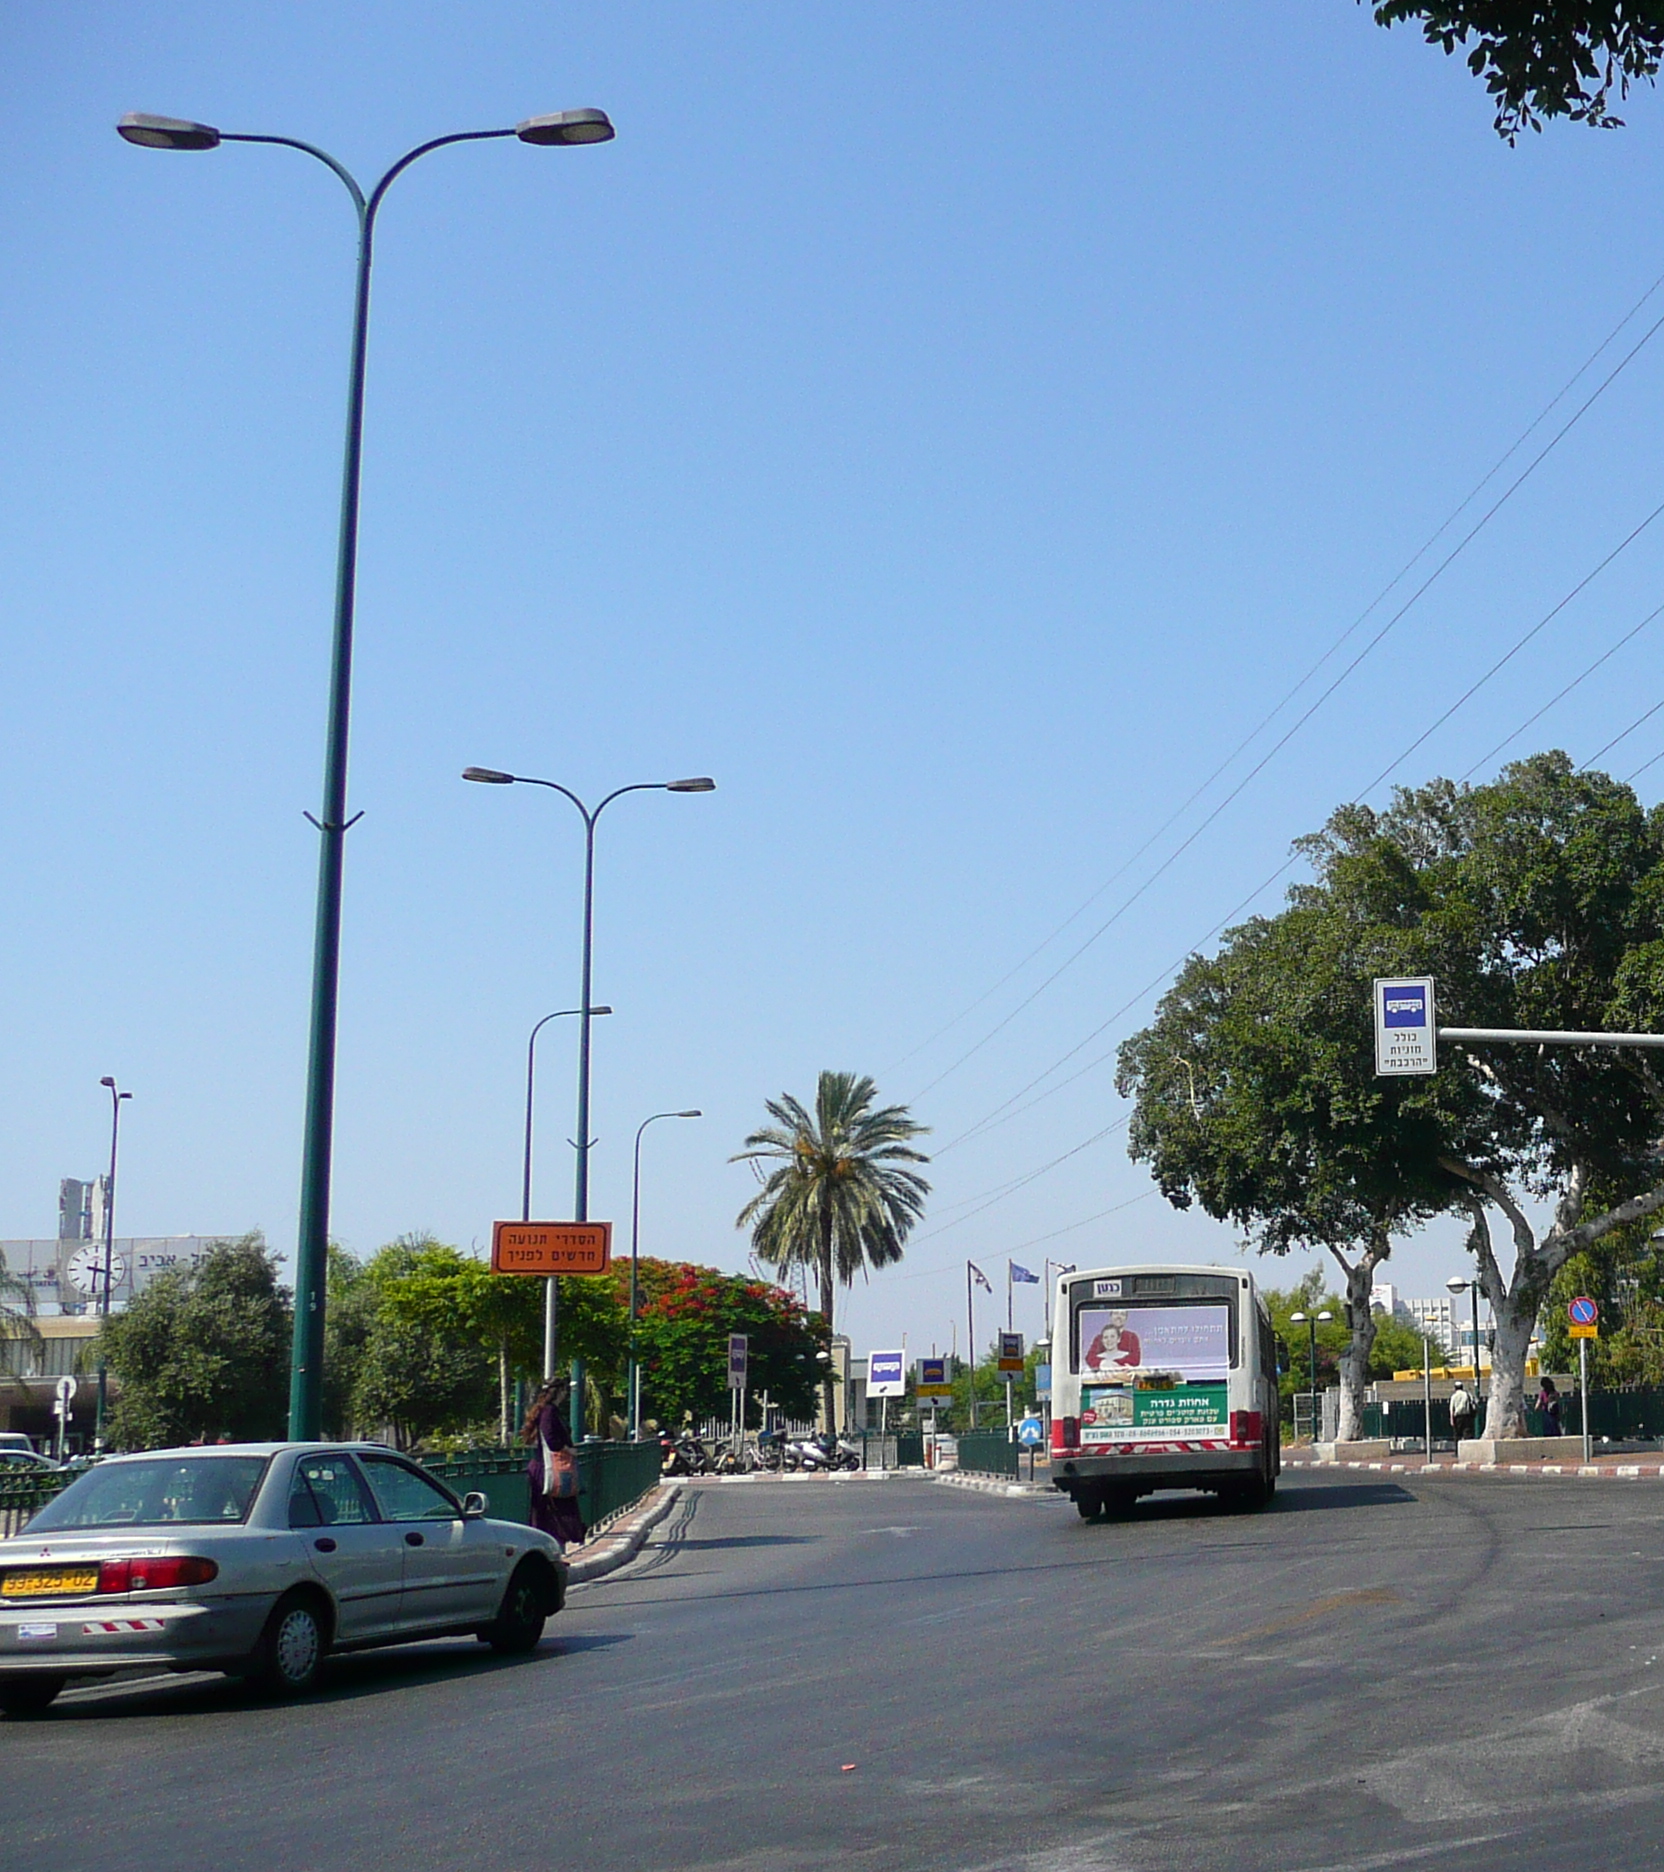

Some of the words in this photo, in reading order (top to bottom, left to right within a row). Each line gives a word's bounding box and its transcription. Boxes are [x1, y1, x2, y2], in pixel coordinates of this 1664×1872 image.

[1394, 1032, 1417, 1042] כולל
[1390, 1045, 1421, 1055] מוניות
[508, 1234, 547, 1245] תנועה
[556, 1234, 596, 1245] הסדרי
[139, 1253, 177, 1268] אביב
[508, 1249, 543, 1262] לפניך
[551, 1250, 596, 1261] חדשים
[1096, 1282, 1120, 1295] כנען
[1150, 1398, 1175, 1408] גדרה
[1178, 1397, 1209, 1407] אחוזת
